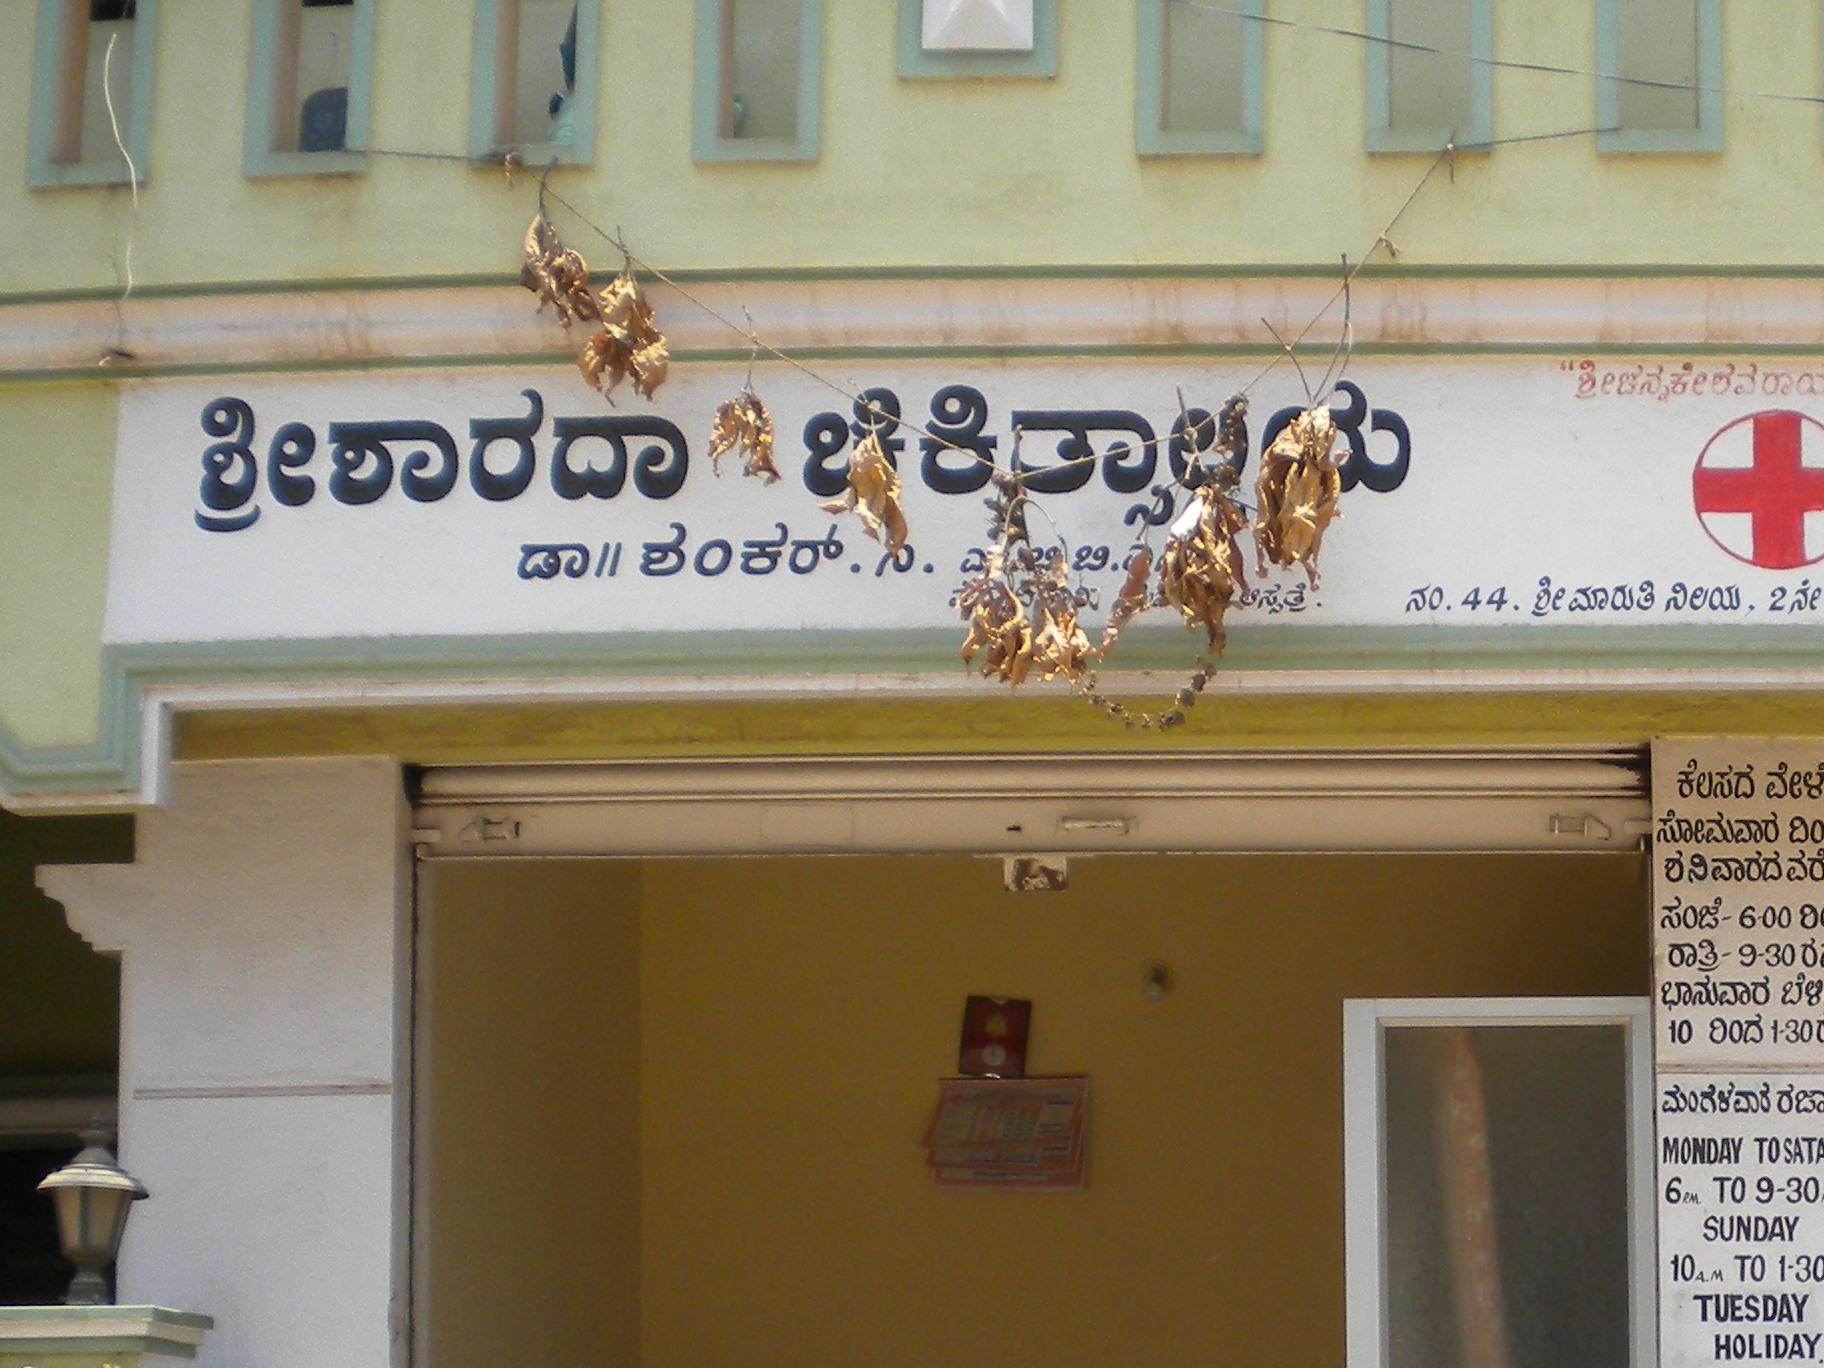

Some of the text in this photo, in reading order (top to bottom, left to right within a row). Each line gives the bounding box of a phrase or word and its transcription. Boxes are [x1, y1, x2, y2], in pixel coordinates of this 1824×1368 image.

[1668, 1018, 1694, 1045] 10
[1662, 1136, 1744, 1165] MONDAY
[1754, 1136, 1780, 1165] TO
[1713, 1176, 1746, 1205] TO
[1702, 1215, 1800, 1243] SUNDAY
[1734, 1254, 1767, 1283] TO
[1692, 1293, 1811, 1323] TUESDAY
